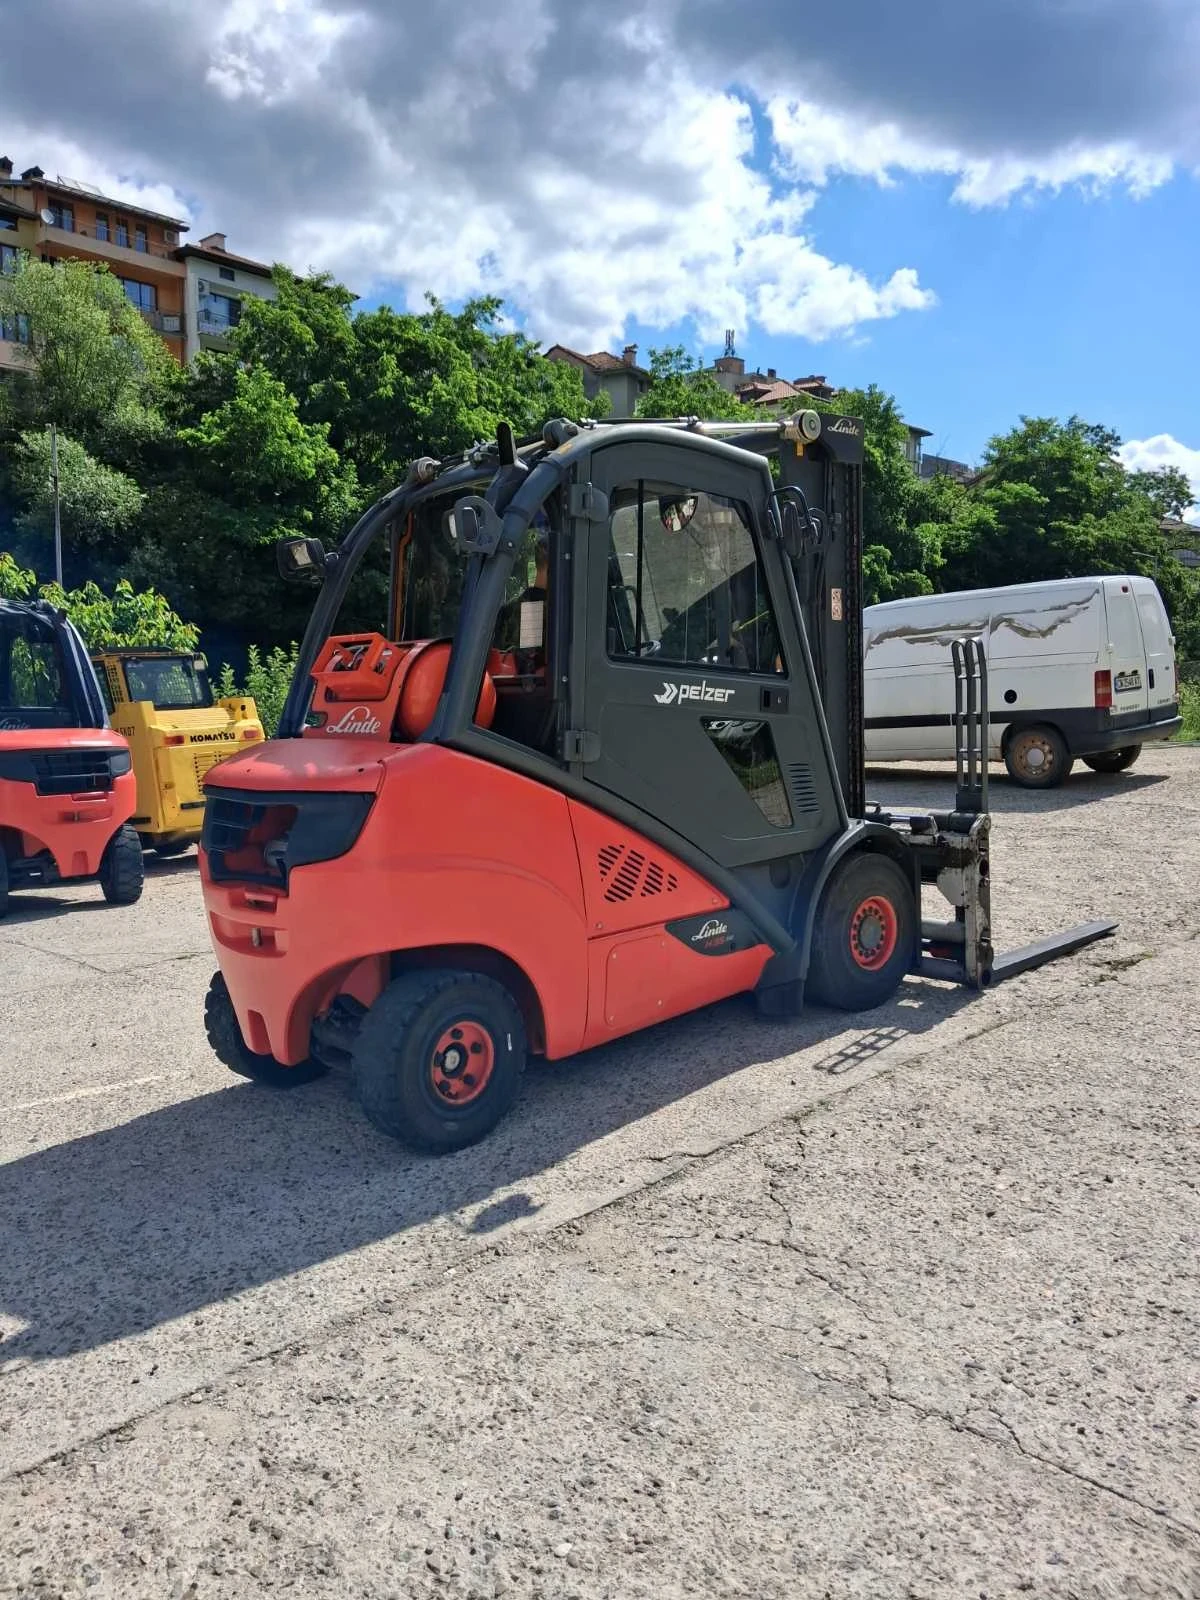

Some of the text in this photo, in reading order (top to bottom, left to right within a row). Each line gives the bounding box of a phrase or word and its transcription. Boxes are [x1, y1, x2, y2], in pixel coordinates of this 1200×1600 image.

[827, 418, 860, 435] Linde
[678, 680, 736, 704] pelzer
[326, 705, 381, 734] Linde
[190, 731, 236, 743] KOMATSU
[691, 919, 729, 941] Linde
